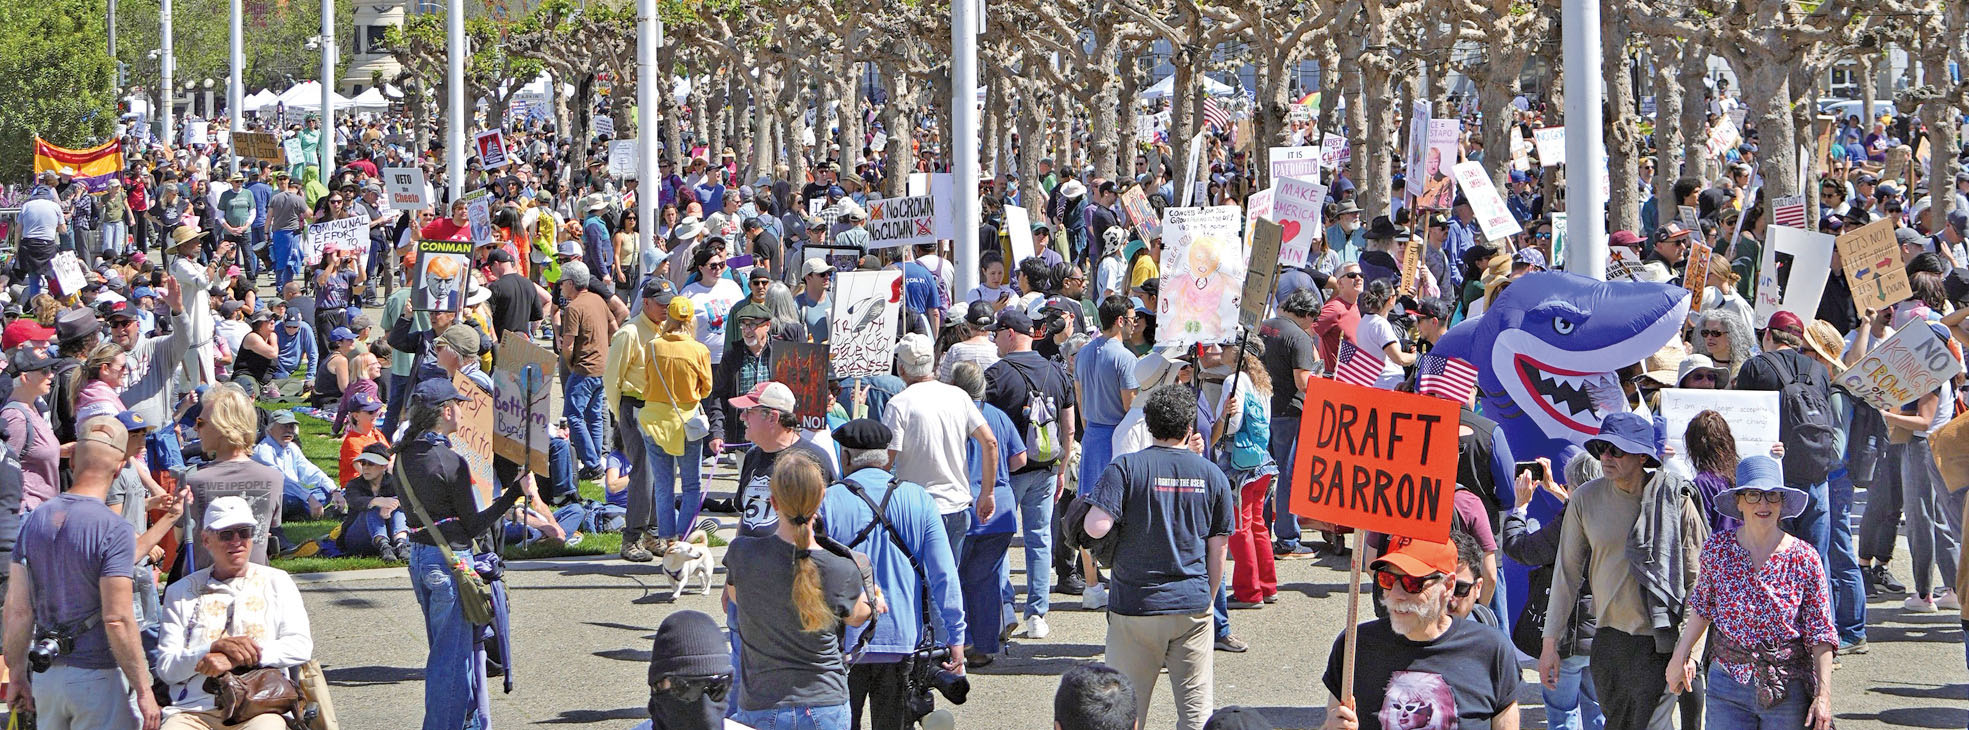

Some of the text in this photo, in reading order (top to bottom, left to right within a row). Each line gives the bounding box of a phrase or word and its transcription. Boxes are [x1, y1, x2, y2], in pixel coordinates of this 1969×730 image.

[1430, 121, 1438, 129] CE
[1287, 151, 1294, 159] IT
[394, 174, 413, 184] VETO
[394, 192, 420, 203] Cheeto
[1281, 183, 1319, 203] MAKE
[1249, 194, 1266, 210] ELECT
[1274, 201, 1314, 222] AMERICA
[308, 216, 369, 235] COMMUNAL
[314, 227, 358, 244] EFFORT
[347, 237, 359, 246] TO
[1869, 228, 1888, 246] NOT
[420, 241, 472, 253] CONMAN
[1279, 247, 1303, 263] AIN
[1759, 292, 1776, 305] The
[1862, 281, 1906, 308] UP DOWN
[1915, 337, 1950, 372] NO
[1880, 338, 1942, 393] KINGS
[1671, 398, 1680, 410] I
[1714, 402, 1735, 415] longer
[803, 416, 825, 429] NO!
[1316, 400, 1441, 466] DRAFT
[206, 481, 224, 490] WE
[230, 480, 273, 490] PEOPLE
[1180, 478, 1190, 487] THE
[1308, 455, 1442, 523] BARRON
